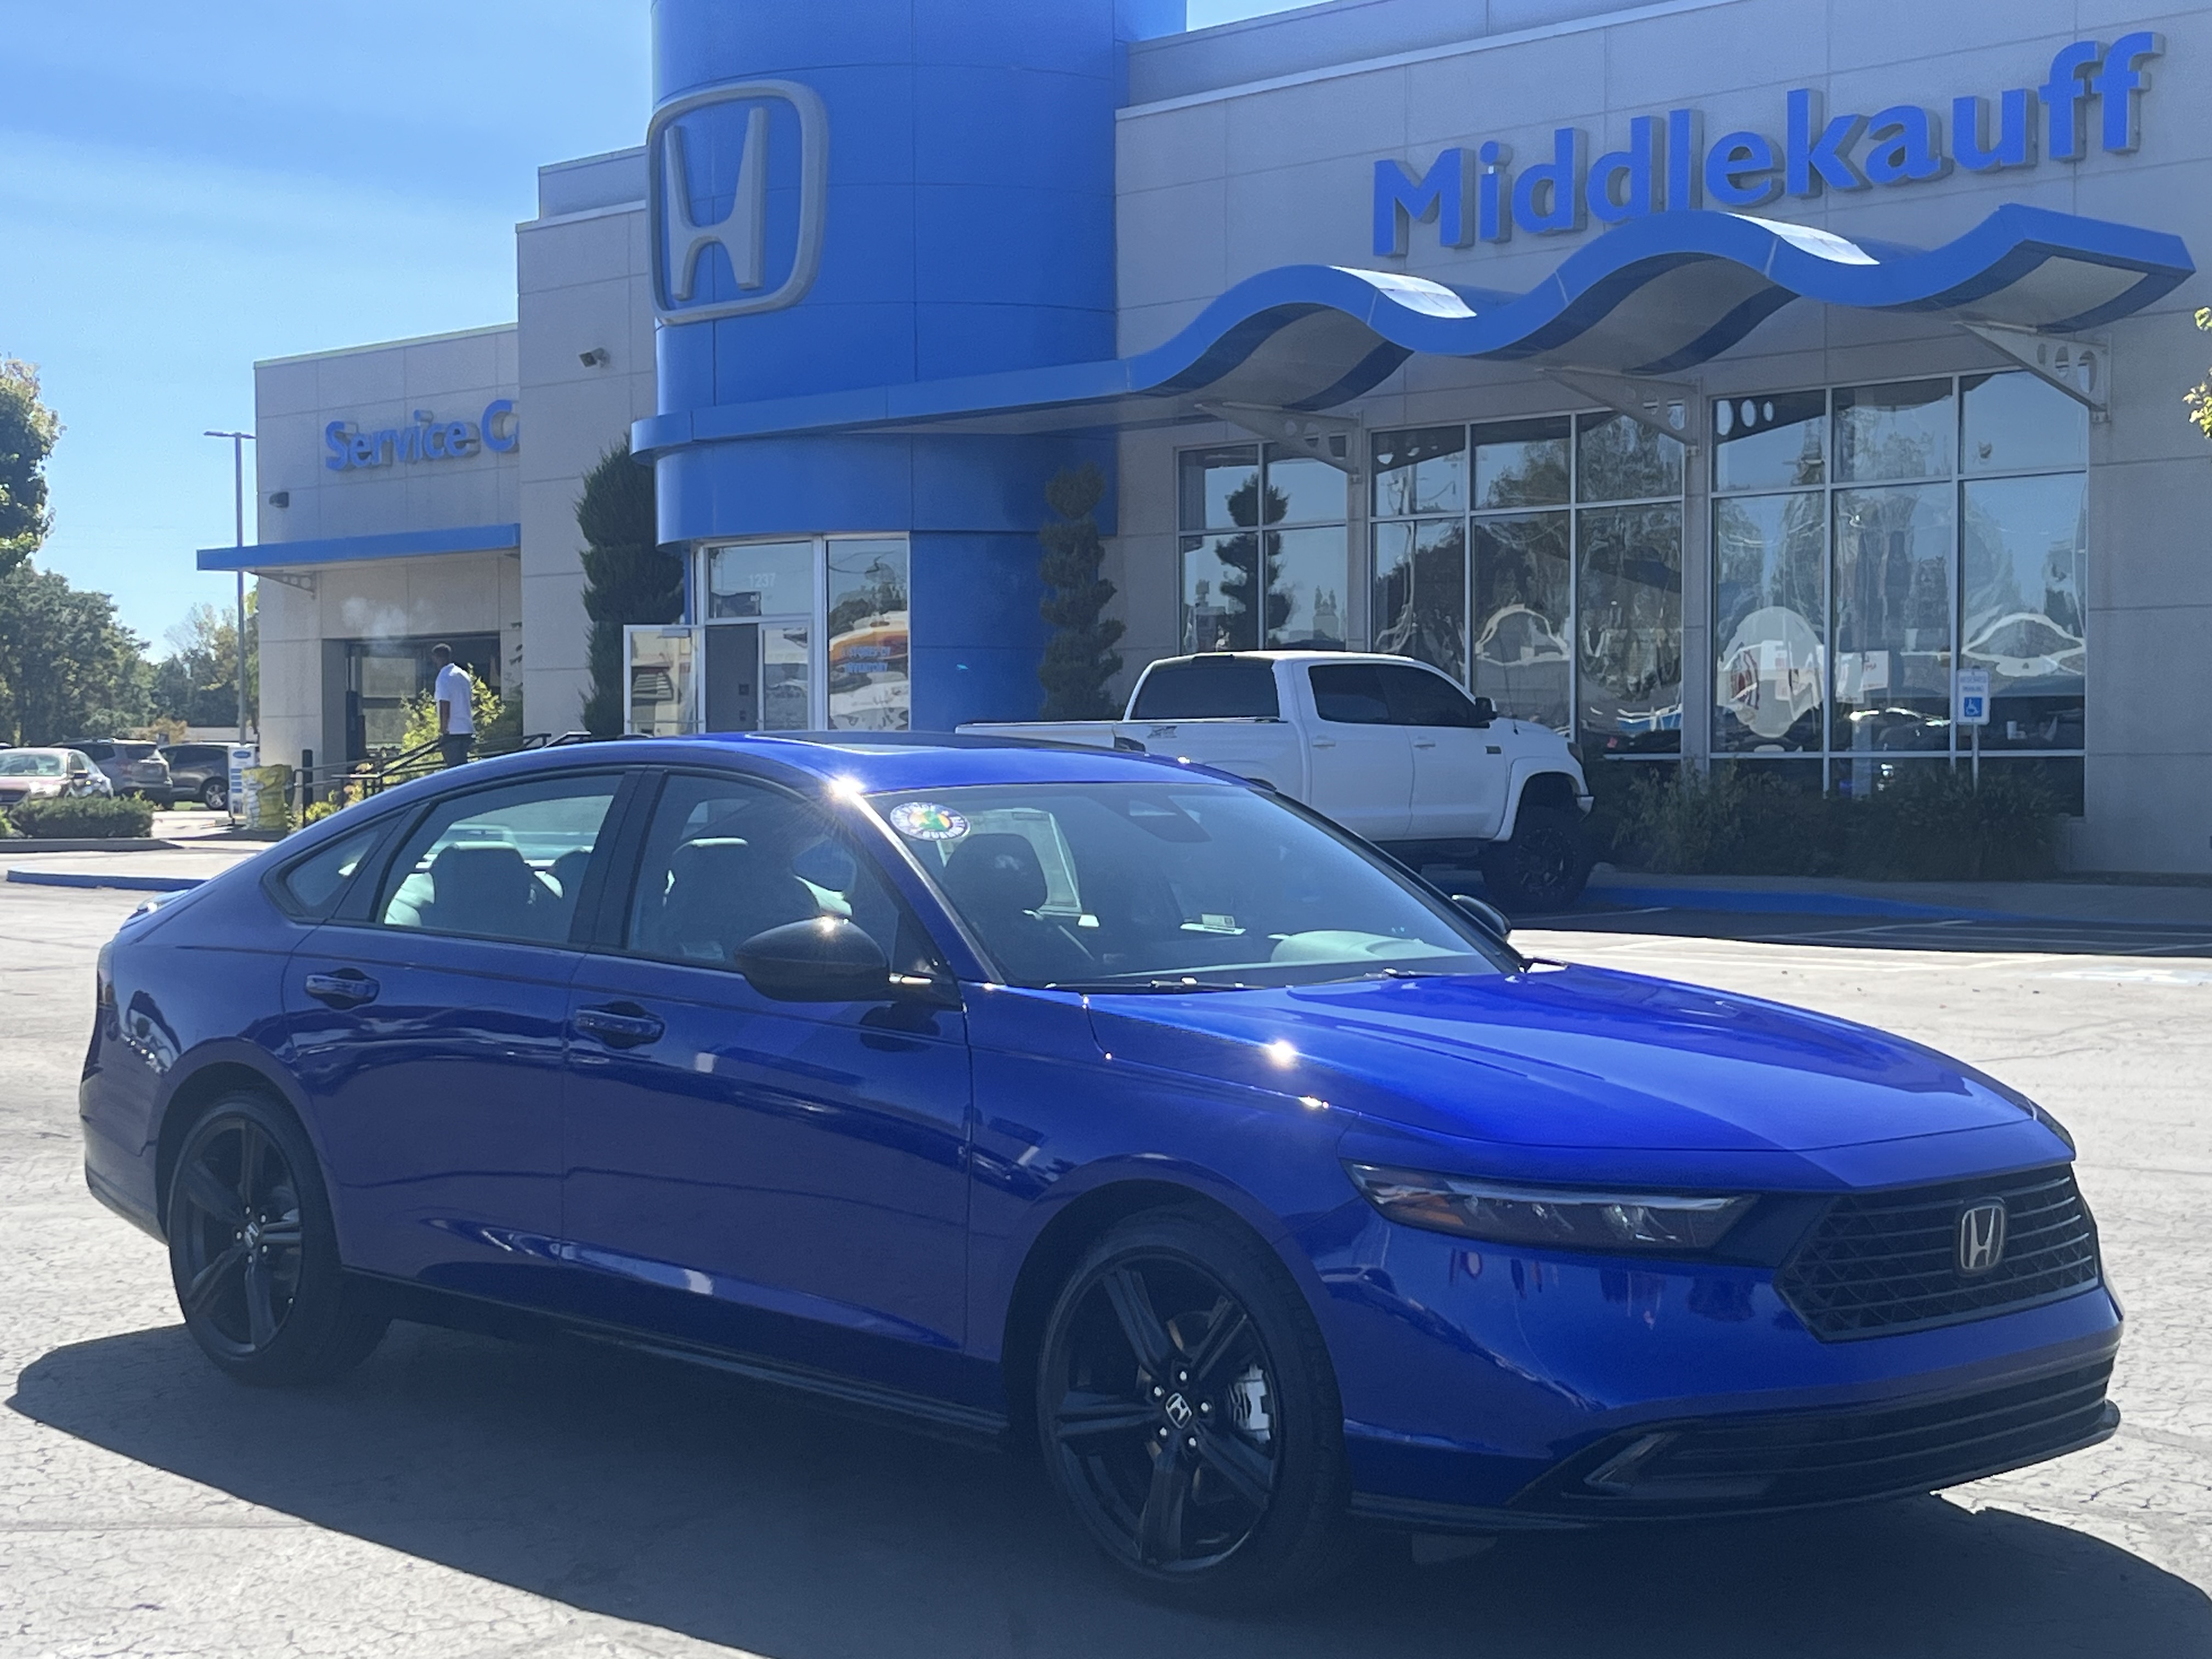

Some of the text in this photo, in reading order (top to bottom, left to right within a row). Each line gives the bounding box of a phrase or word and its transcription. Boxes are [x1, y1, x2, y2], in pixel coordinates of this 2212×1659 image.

[1373, 31, 2163, 257] Middlekauff
[325, 399, 519, 471] Service C
[748, 573, 776, 588] 1237
